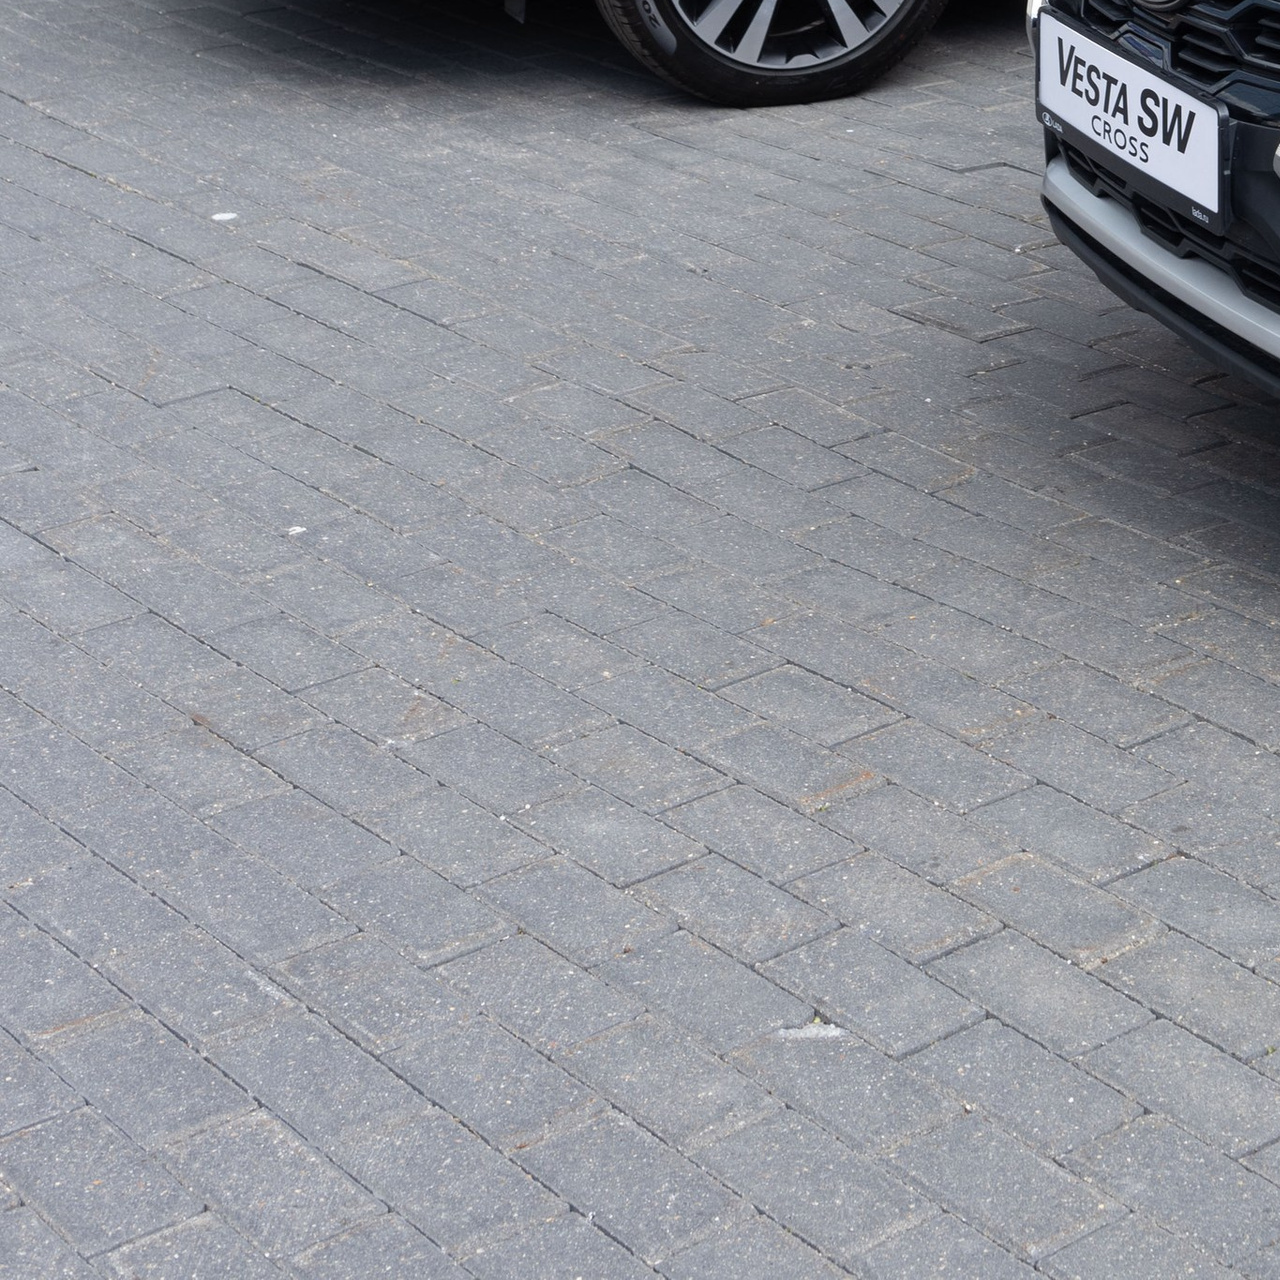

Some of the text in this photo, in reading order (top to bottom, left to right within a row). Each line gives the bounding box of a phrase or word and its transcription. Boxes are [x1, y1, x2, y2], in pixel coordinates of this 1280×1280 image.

[1057, 36, 1196, 155] VESTA SW
[1091, 113, 1150, 164] CROSS
